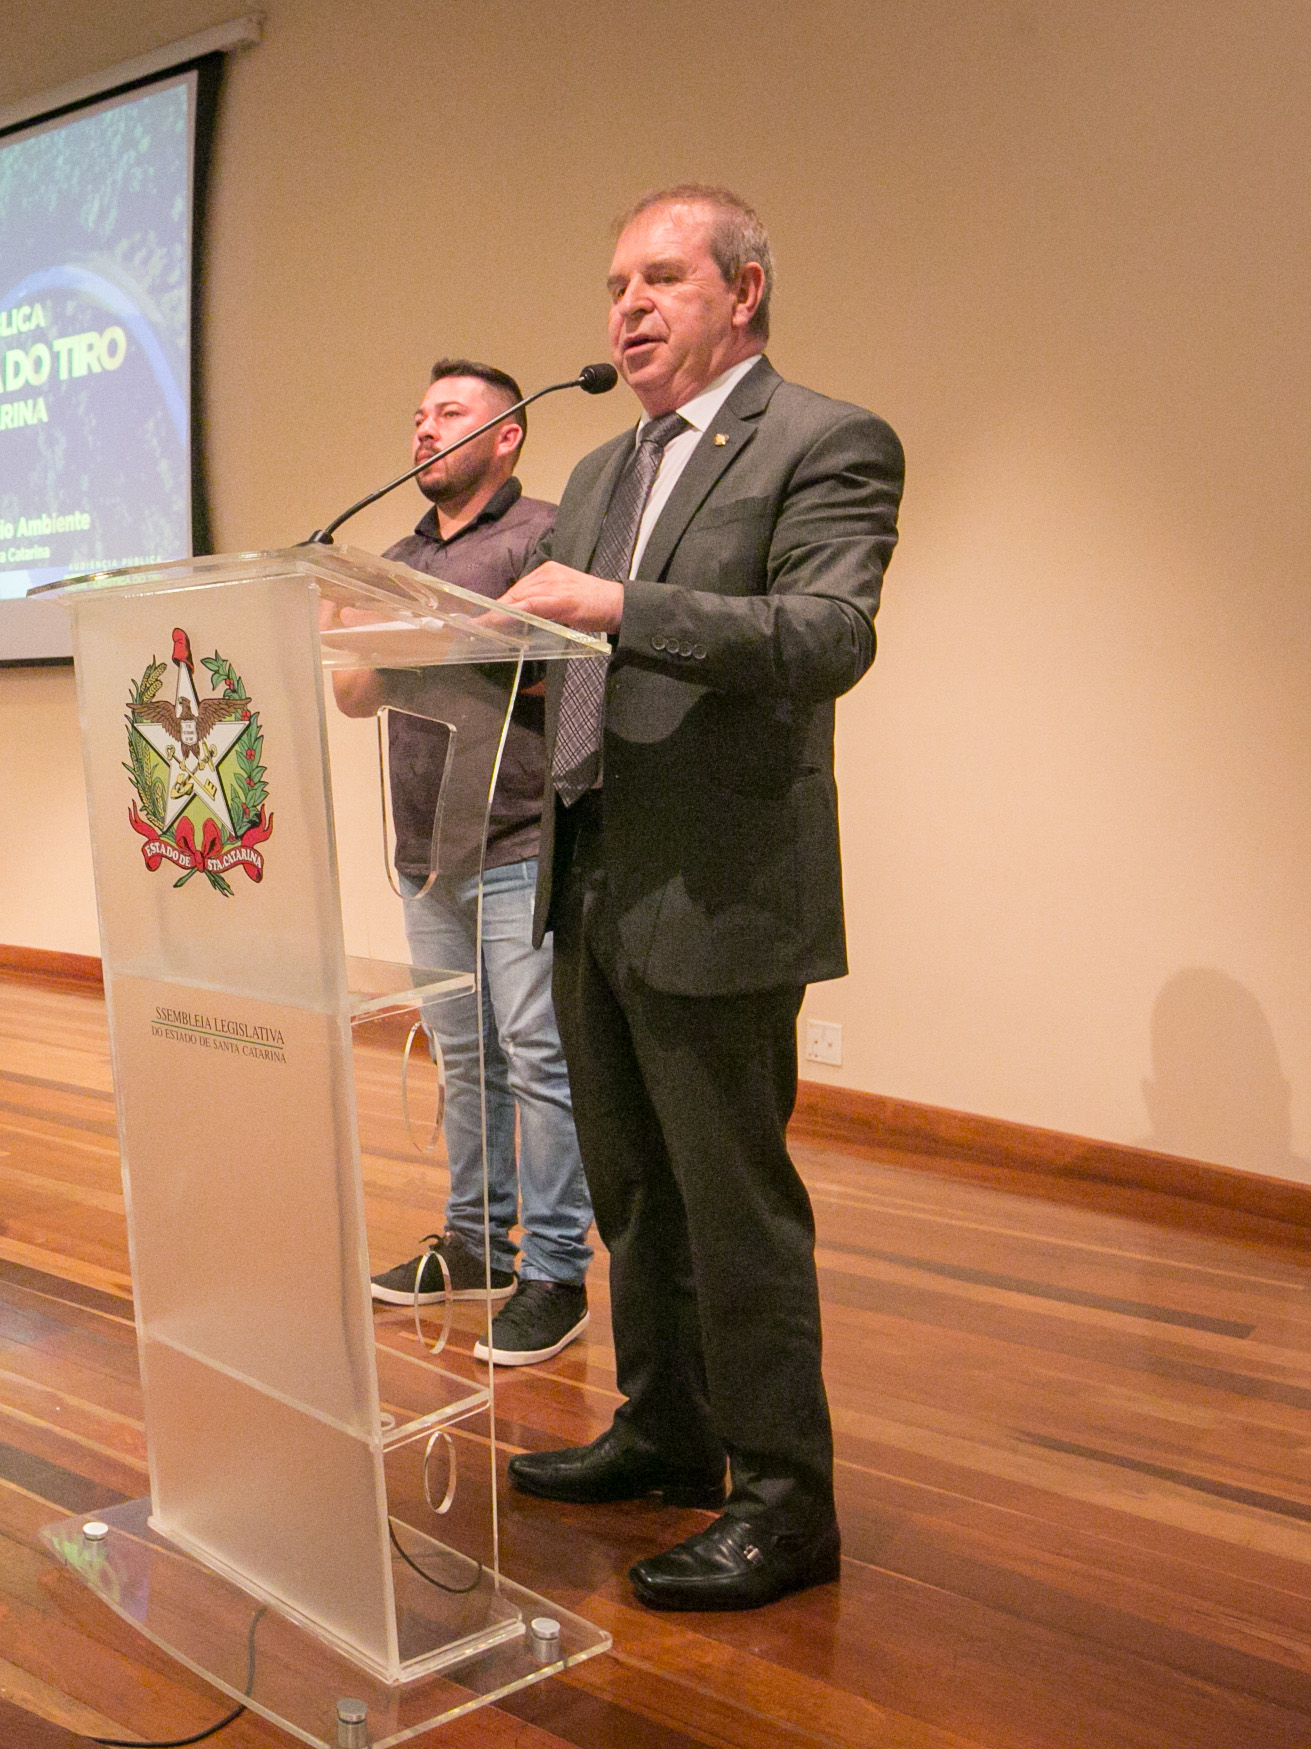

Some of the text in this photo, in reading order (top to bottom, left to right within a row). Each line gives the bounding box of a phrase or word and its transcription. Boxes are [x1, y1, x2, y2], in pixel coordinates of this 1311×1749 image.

[4, 342, 51, 392] DO
[52, 325, 127, 381] TIRO
[15, 510, 91, 538] Ambiente
[7, 544, 51, 563] Catarina
[145, 841, 179, 861] ESTADO
[179, 853, 191, 867] DE
[151, 1025, 287, 1064] DO ESTADO DE SANTA CATARINA
[213, 1017, 285, 1045] LEGISLATIVA
